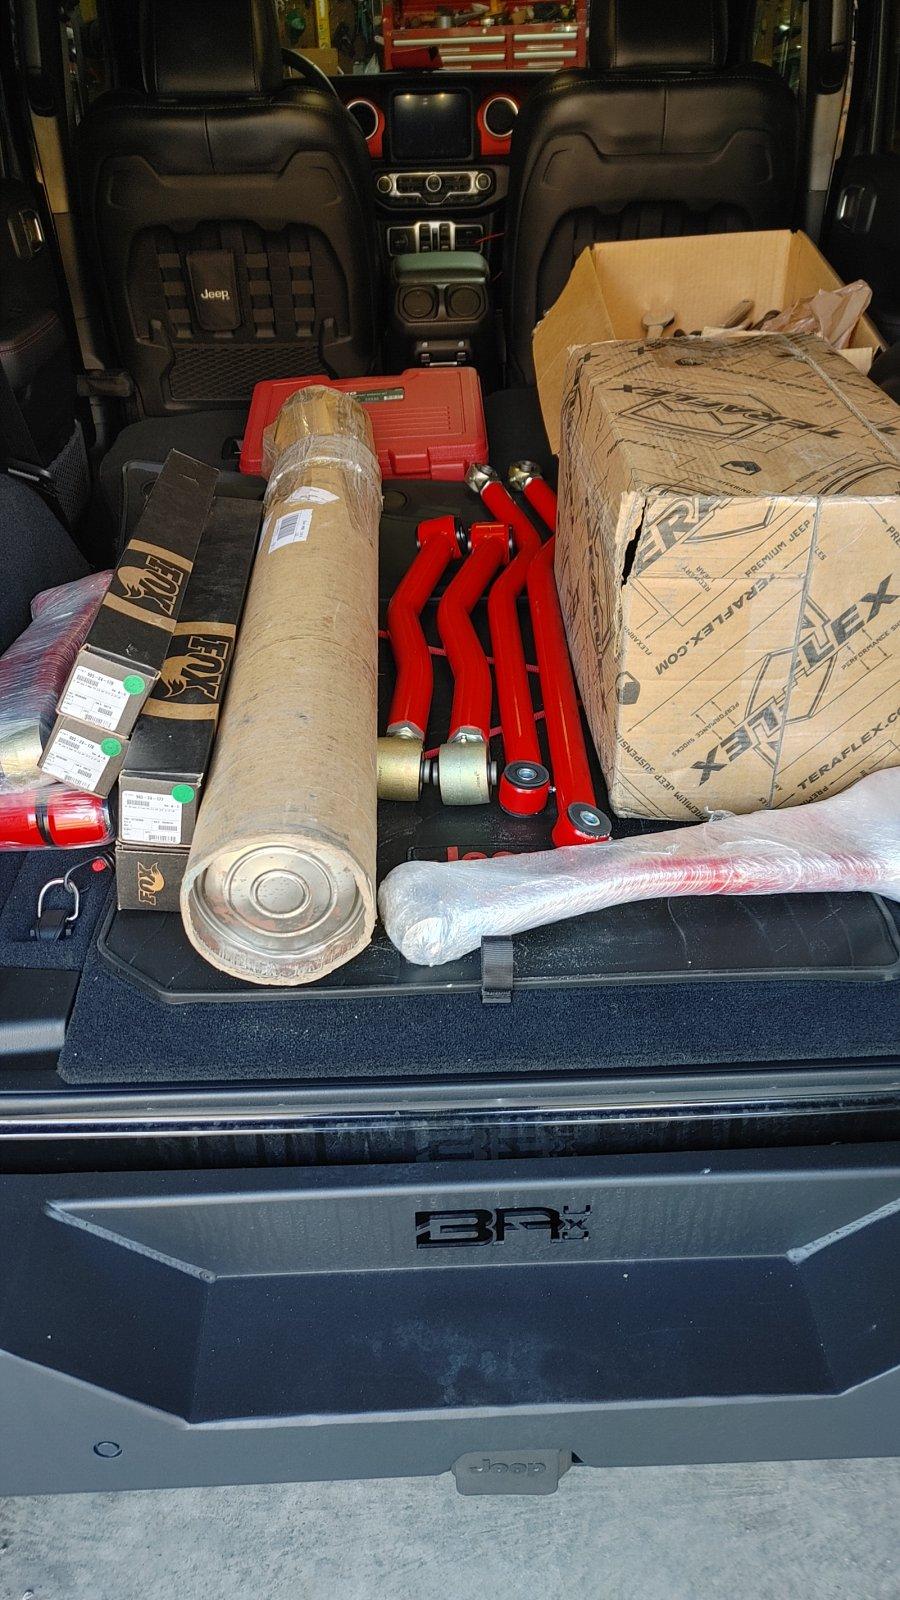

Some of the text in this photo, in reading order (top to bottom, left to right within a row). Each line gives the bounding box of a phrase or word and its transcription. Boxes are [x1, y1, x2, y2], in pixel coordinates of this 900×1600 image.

[200, 288, 229, 301] Jeep
[744, 519, 811, 577] PREMIUM JEEP
[144, 554, 184, 615] FOX
[187, 636, 231, 700] FOX
[842, 633, 889, 670] PERFORMANCE
[696, 702, 740, 738] PERFORMANCE
[654, 774, 675, 791] JEEP
[138, 862, 158, 907] FOX
